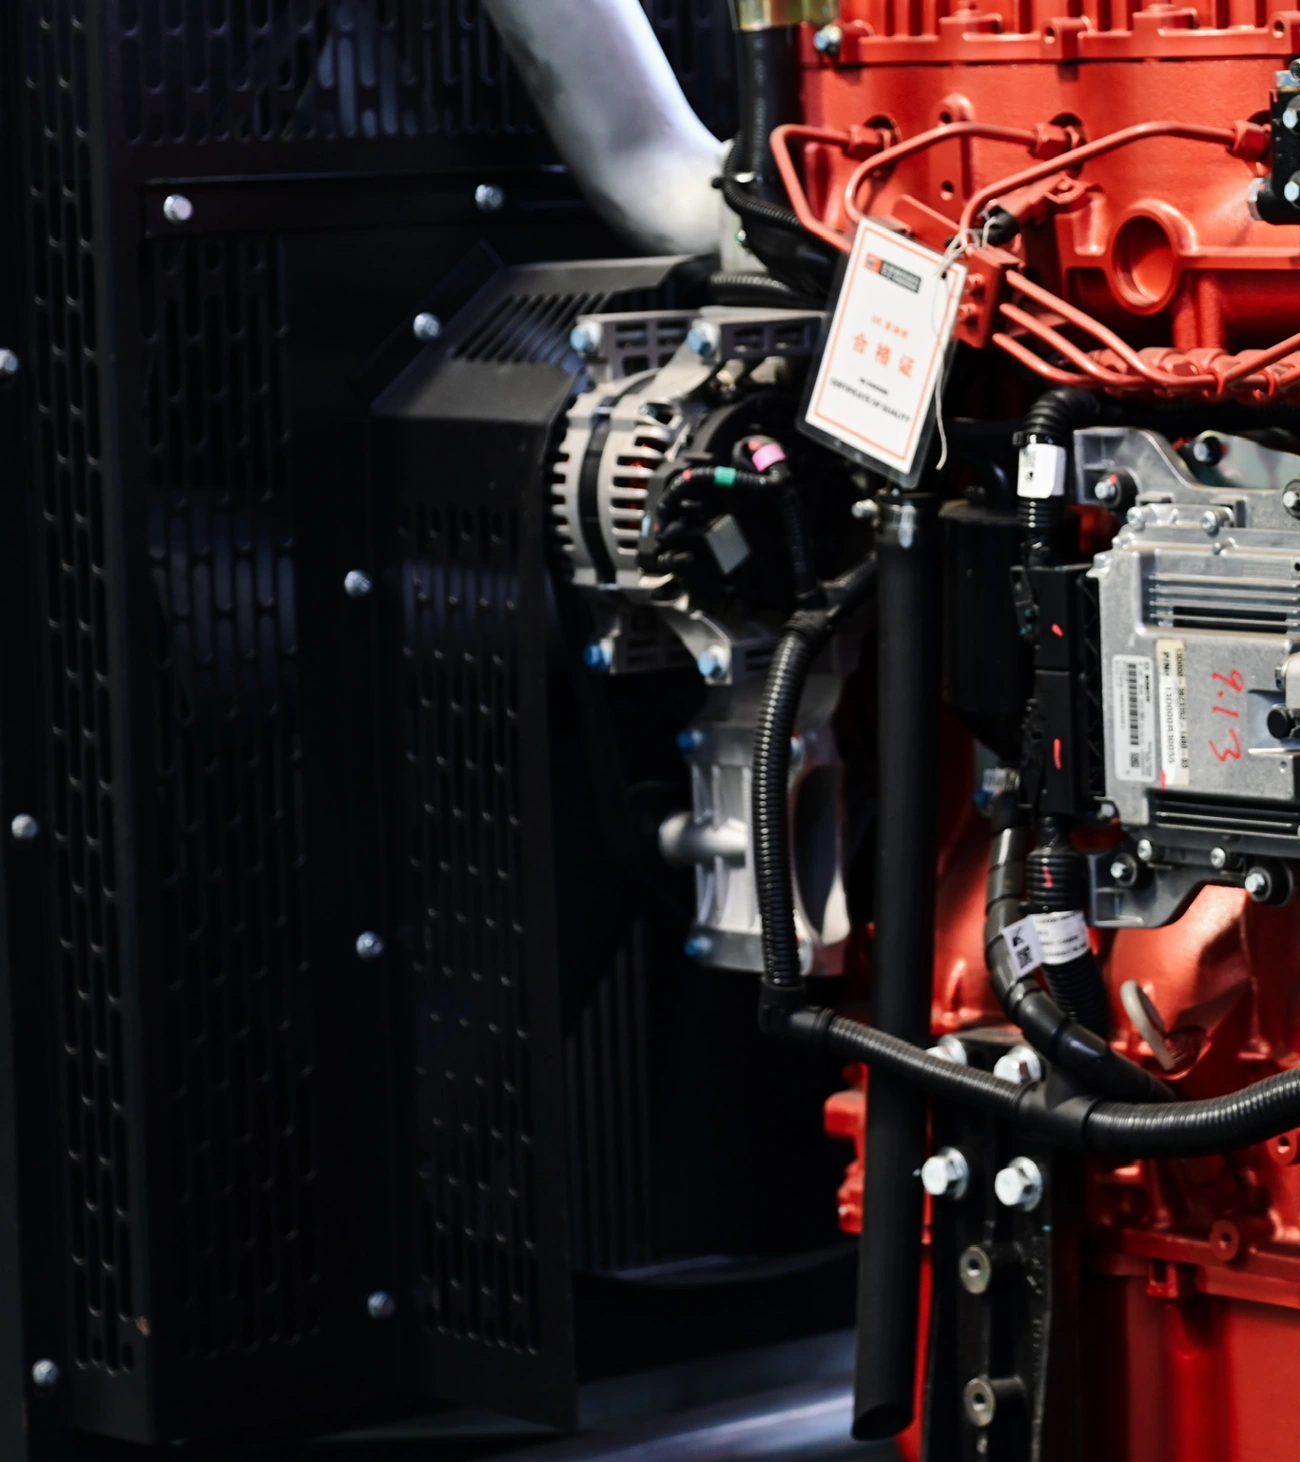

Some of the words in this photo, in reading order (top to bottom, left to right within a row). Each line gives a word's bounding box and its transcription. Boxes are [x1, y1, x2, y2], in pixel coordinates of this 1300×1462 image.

[851, 332, 916, 377] 合格证
[830, 378, 870, 403] CERTIFICATE
[882, 403, 910, 422] QUALITY
[1209, 669, 1246, 764] 9.13
